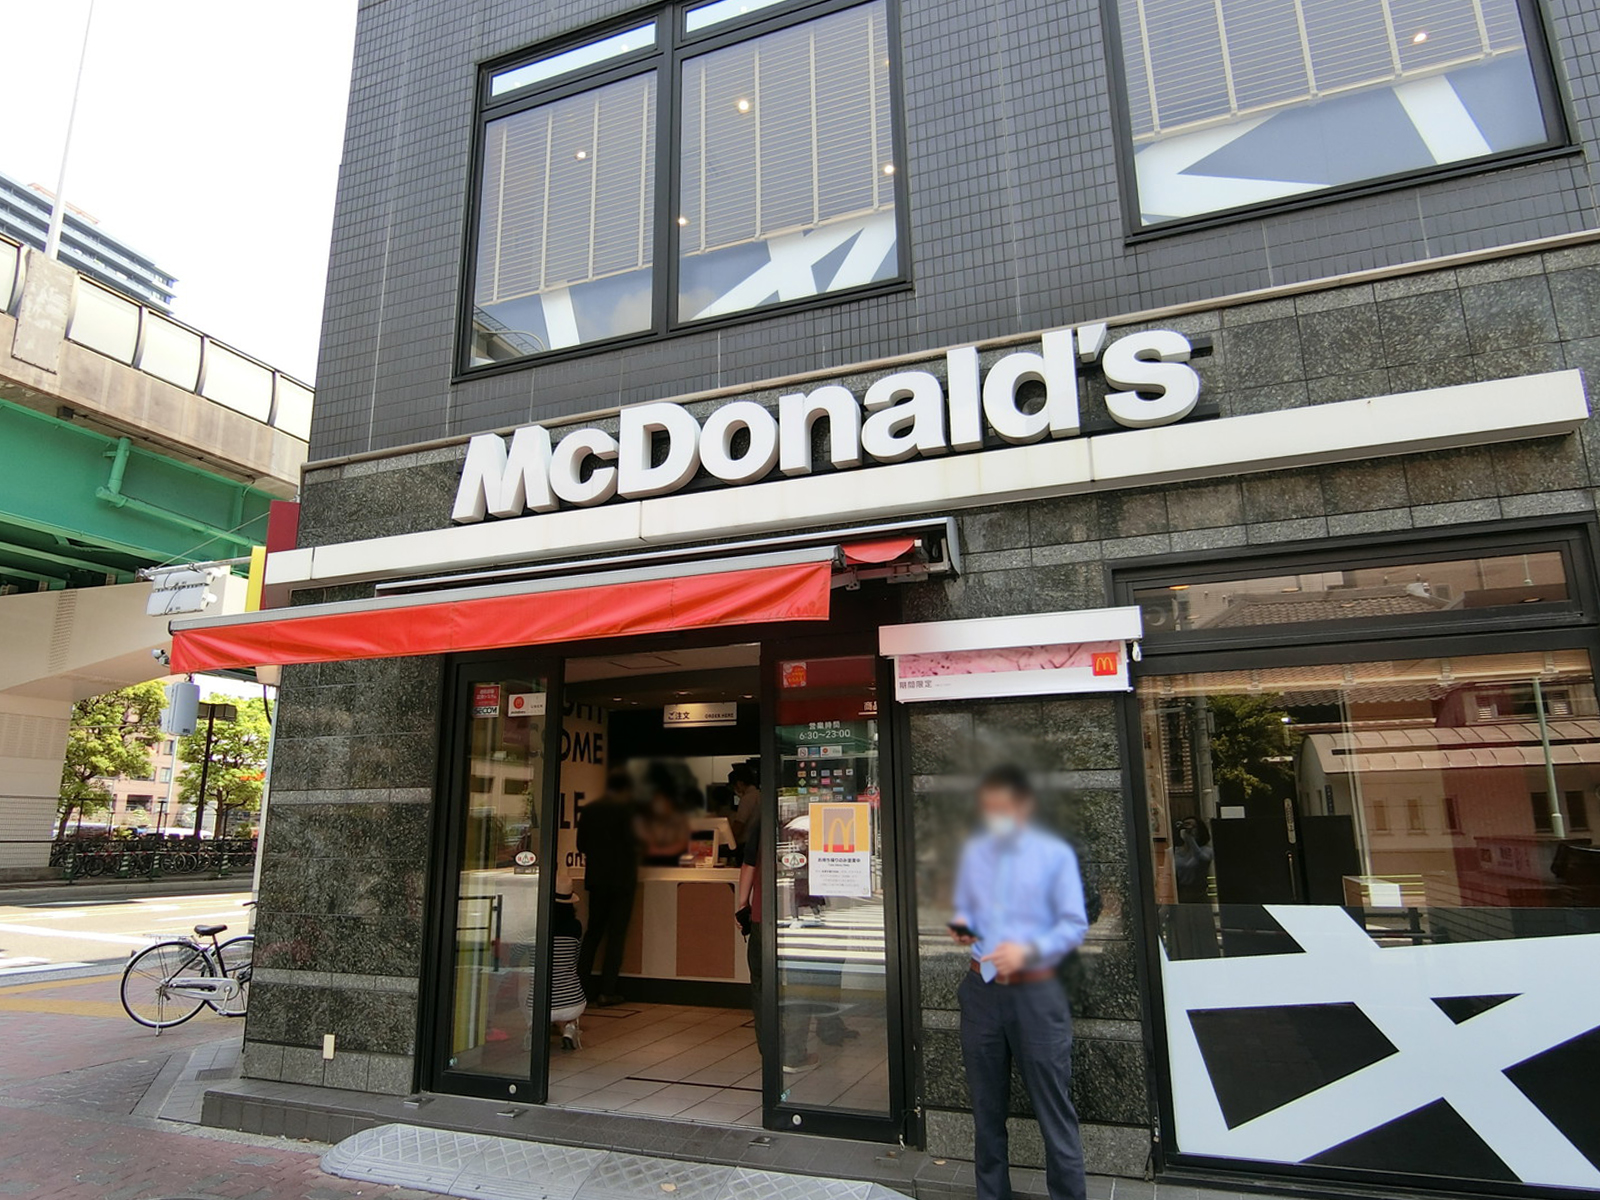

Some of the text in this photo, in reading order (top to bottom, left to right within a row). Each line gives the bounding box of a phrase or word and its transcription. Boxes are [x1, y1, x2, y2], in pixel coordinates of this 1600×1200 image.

[451, 322, 1201, 523] McDonald's
[899, 680, 932, 689] 期間限定
[668, 711, 690, 720] ご注文
[566, 851, 587, 868] an
